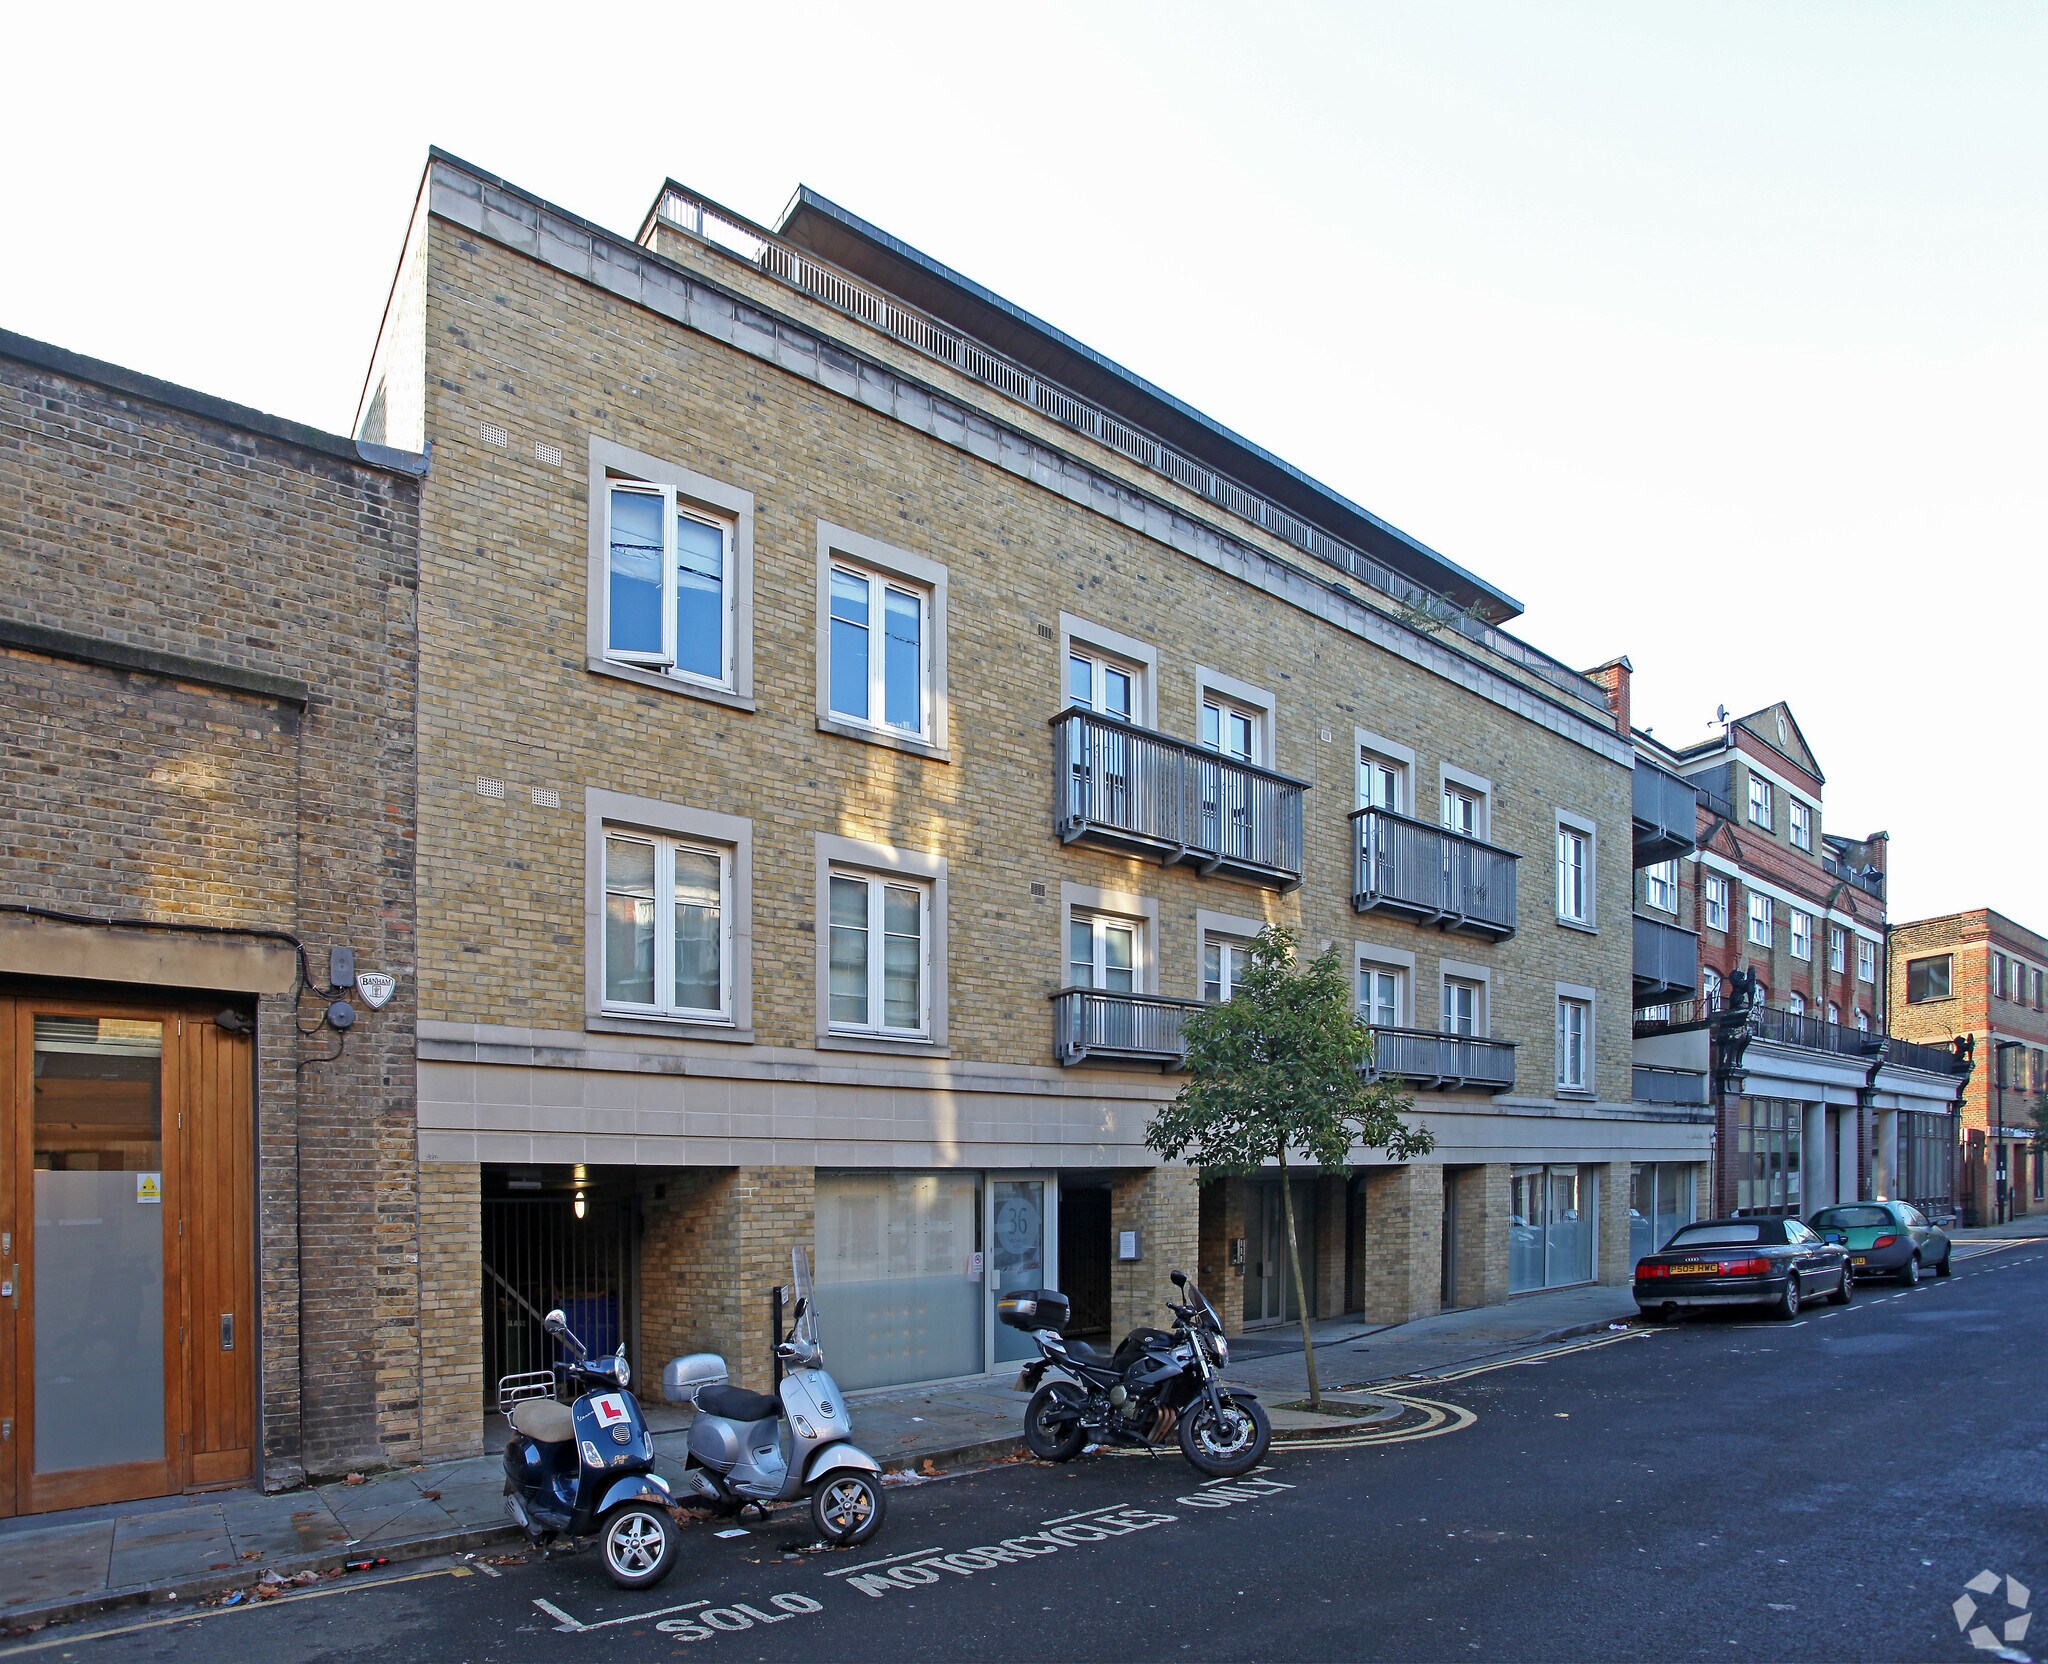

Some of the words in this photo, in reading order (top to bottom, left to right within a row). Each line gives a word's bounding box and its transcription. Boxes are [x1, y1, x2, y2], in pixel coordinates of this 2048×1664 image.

[362, 977, 391, 986] BANHAM
[1008, 1207, 1027, 1234] 36
[1670, 1265, 1695, 1273] P509
[1697, 1264, 1717, 1272] HWC
[601, 1400, 622, 1418] L
[655, 1593, 824, 1642] SOLO
[846, 1509, 1179, 1598] MOTORCYCLES
[1175, 1477, 1297, 1508] ONLY
